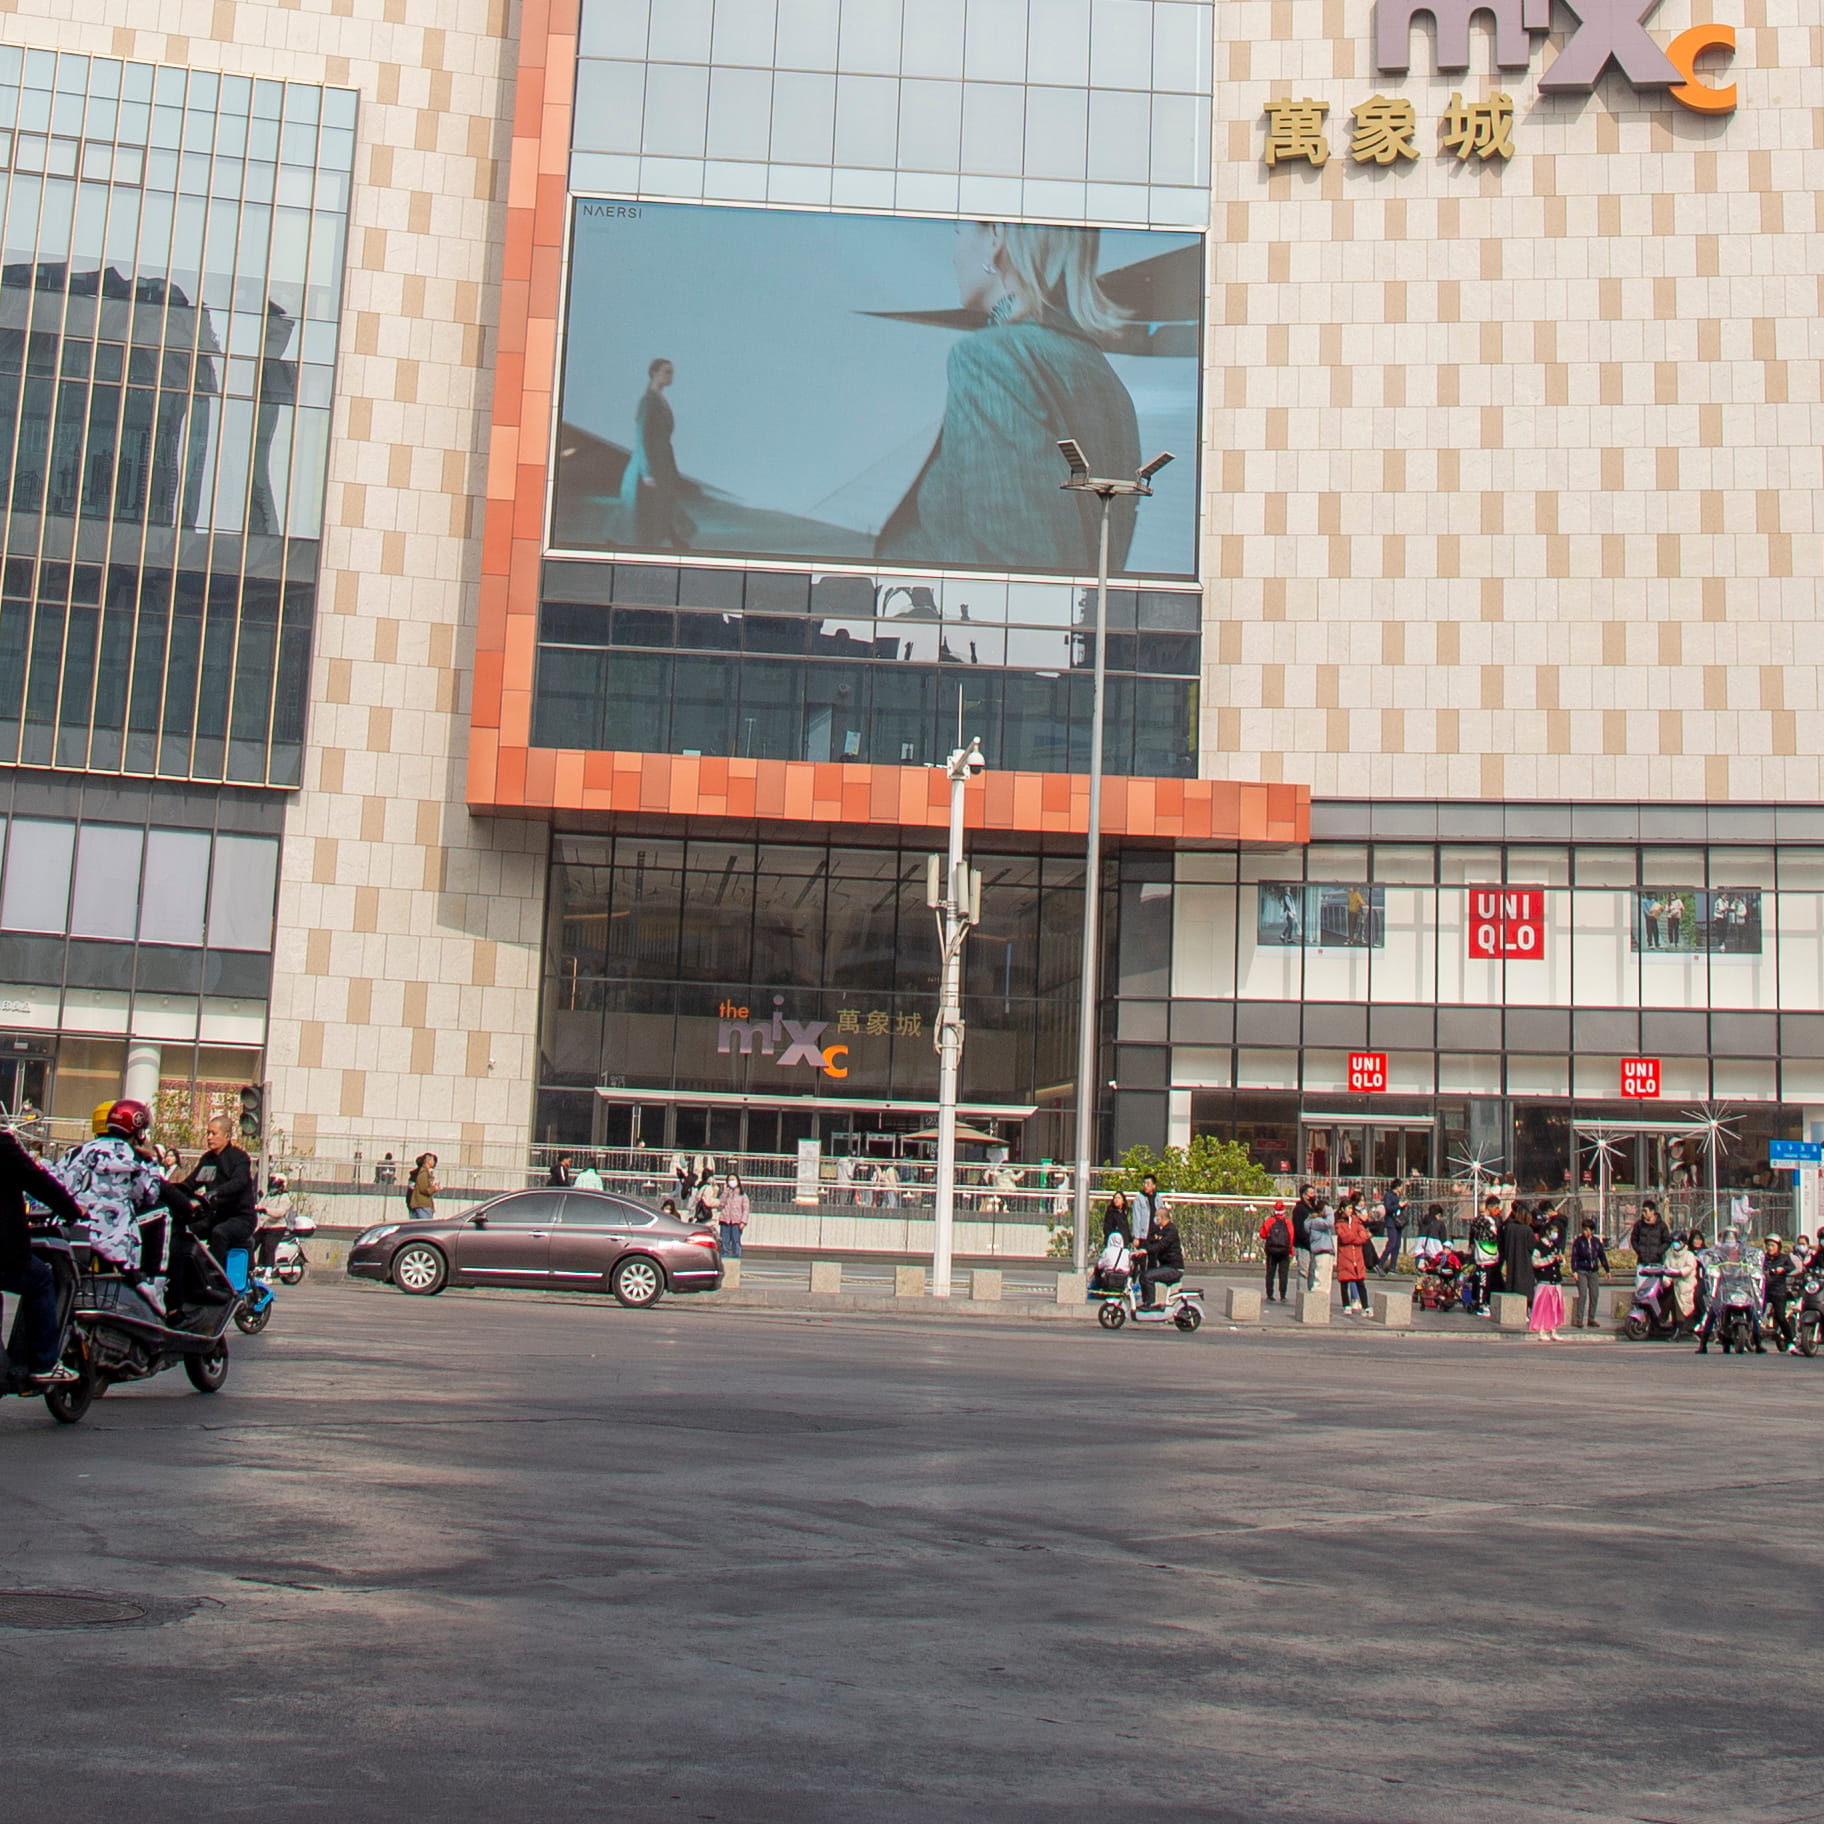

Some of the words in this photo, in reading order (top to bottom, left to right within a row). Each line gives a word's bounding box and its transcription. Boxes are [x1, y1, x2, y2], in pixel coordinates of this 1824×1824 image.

[1263, 91, 1515, 168] 萬象城
[1478, 894, 1530, 919] UNI
[1478, 924, 1535, 953] QLO
[719, 999, 749, 1020] the
[836, 1009, 922, 1038] 萬象城
[1352, 1057, 1381, 1073] UNI
[1625, 1062, 1654, 1078] UNI
[1352, 1073, 1384, 1089] QLO
[1625, 1079, 1656, 1095] QLO
